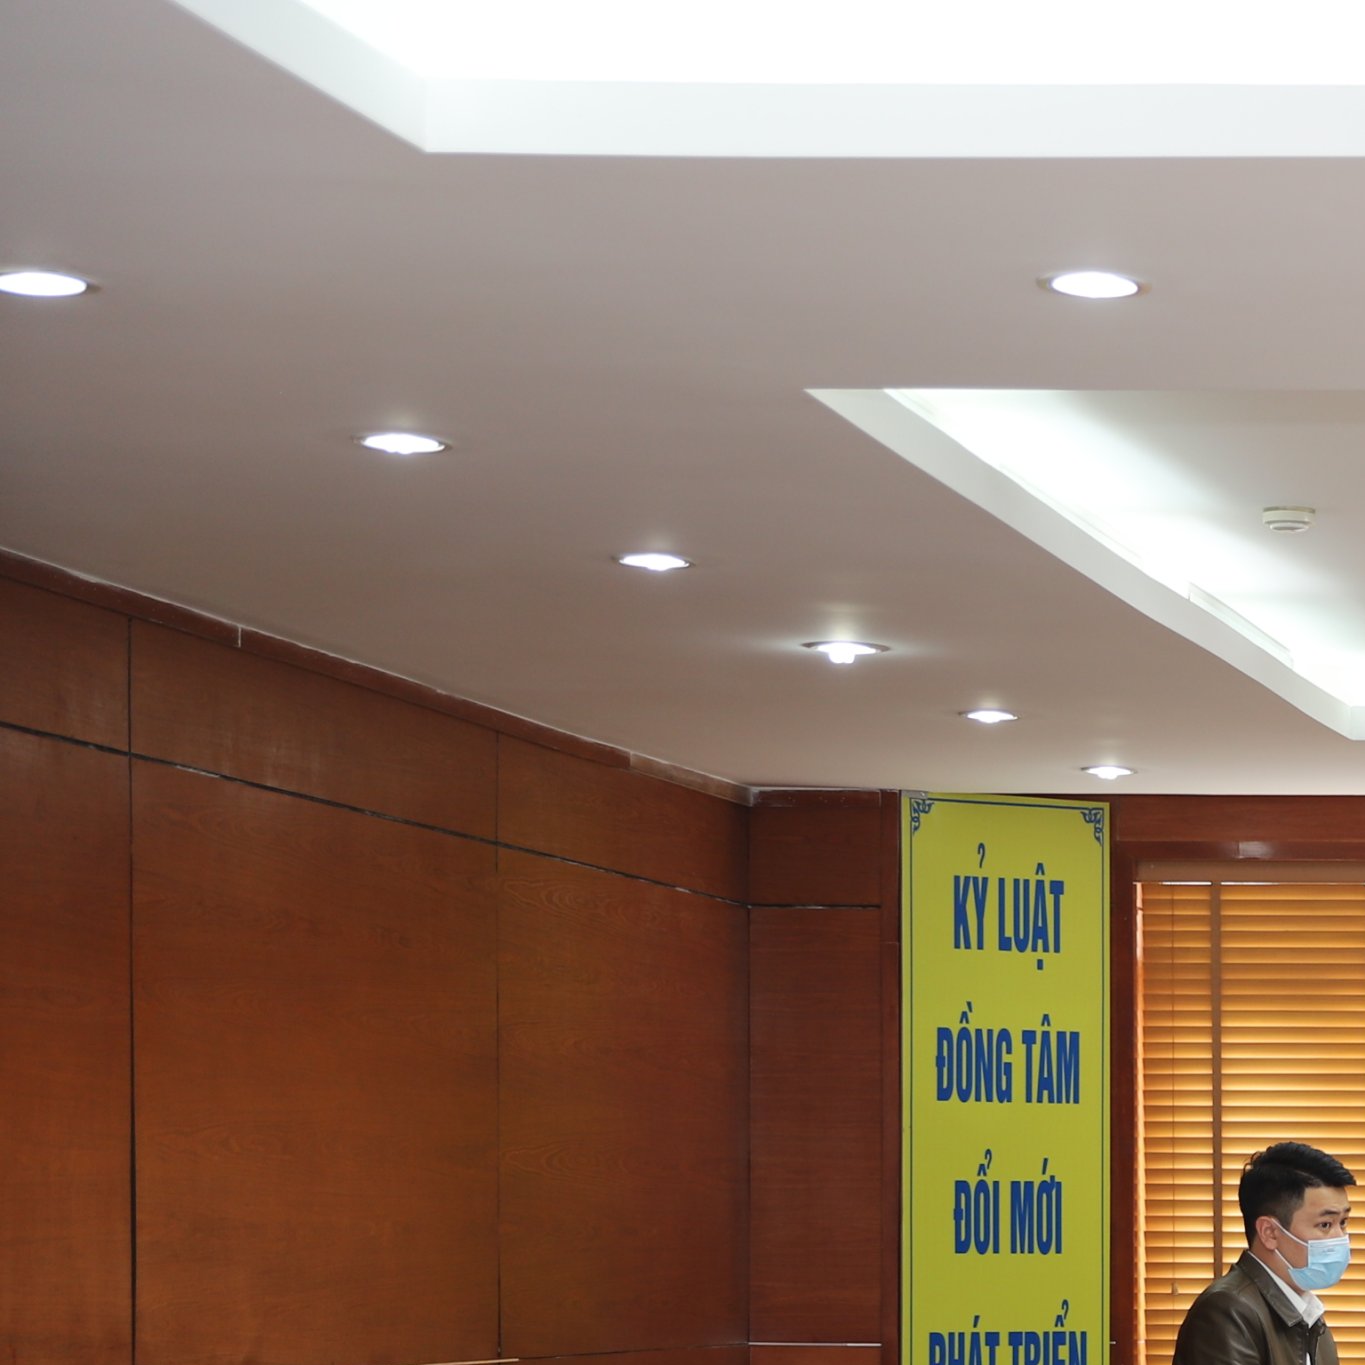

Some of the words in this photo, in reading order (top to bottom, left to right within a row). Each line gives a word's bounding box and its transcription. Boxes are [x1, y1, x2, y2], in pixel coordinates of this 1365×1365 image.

[952, 842, 990, 951] KỶ
[998, 862, 1066, 971] LUẬT
[935, 1001, 1014, 1104] ĐỒNG
[1021, 1013, 1081, 1105] TÂM
[953, 1148, 1001, 1256] ĐỔI
[1009, 1157, 1064, 1256] MỚI
